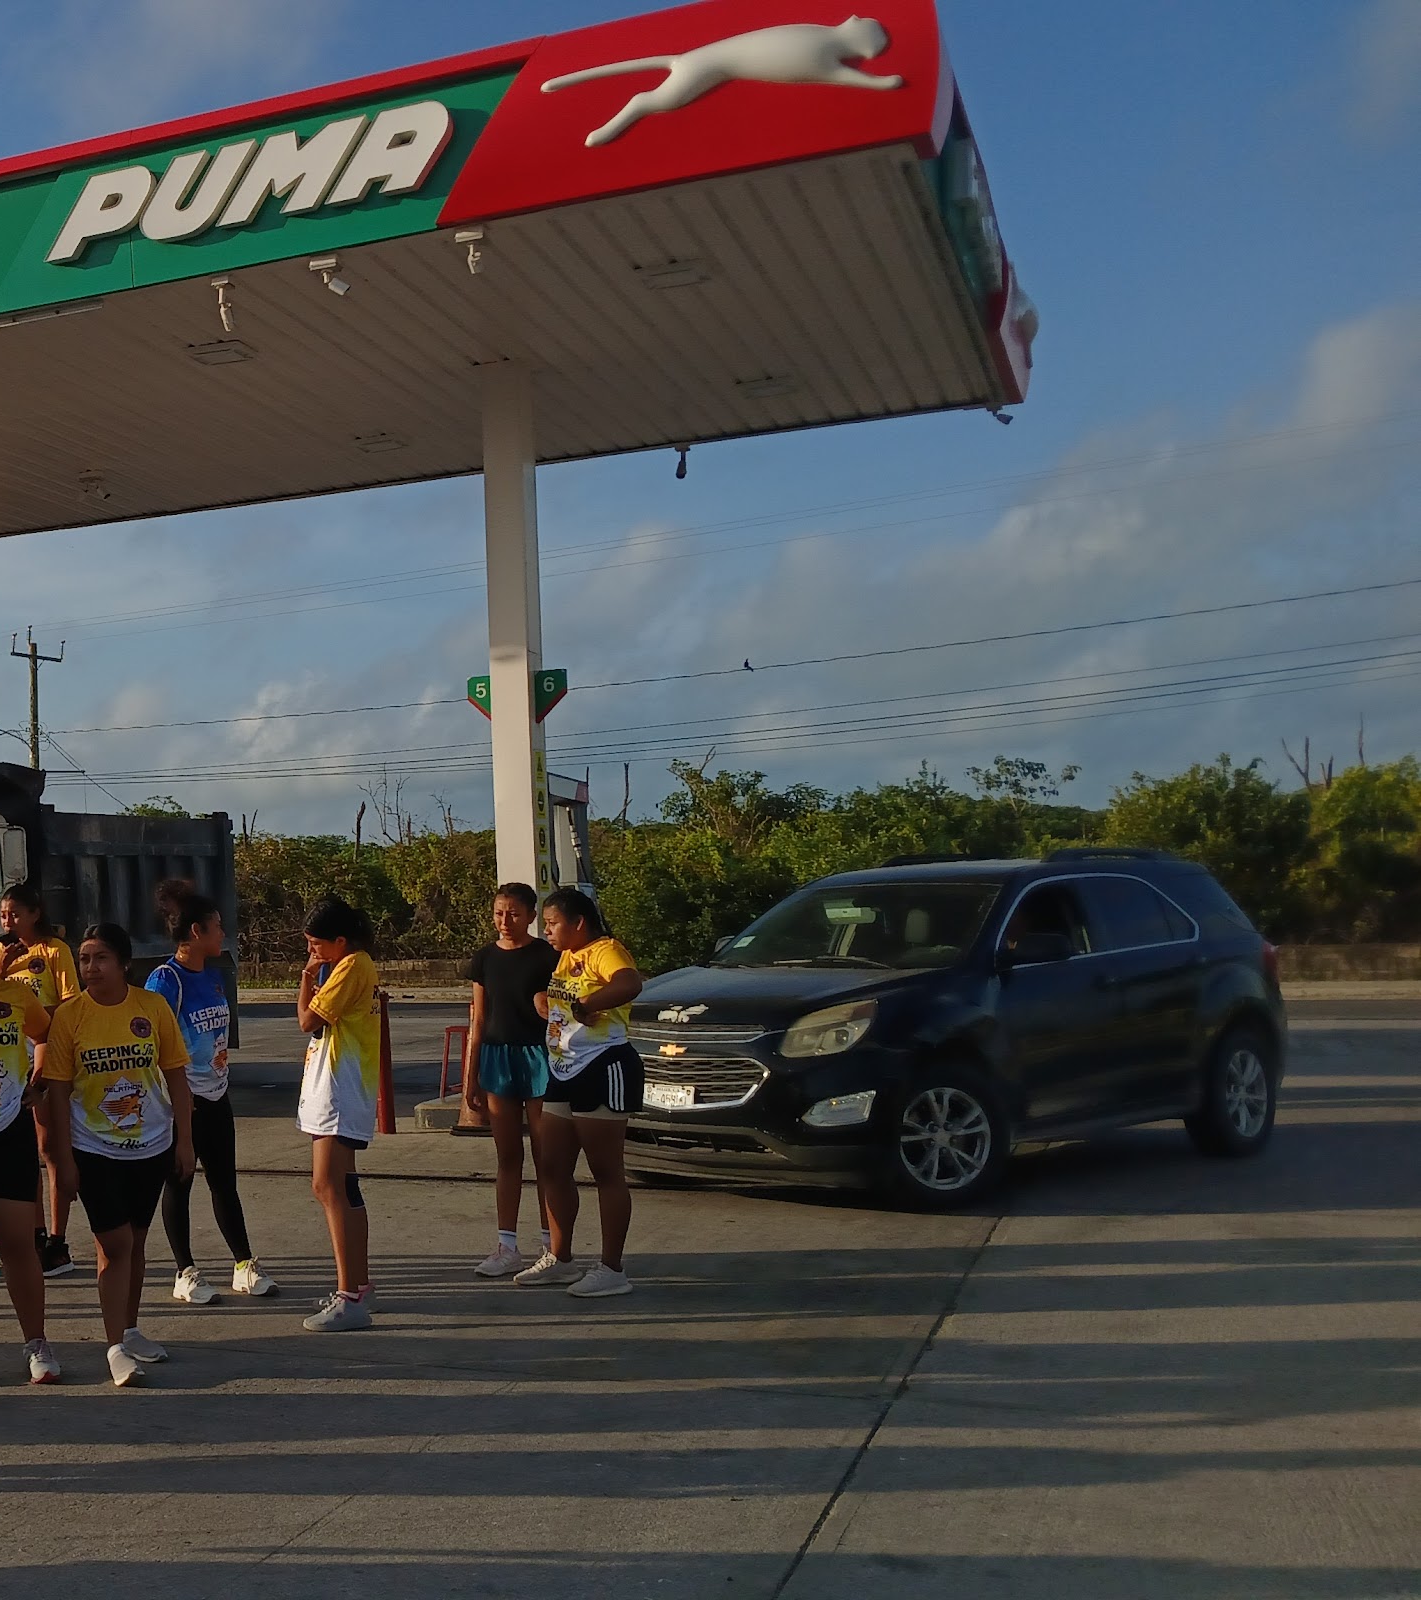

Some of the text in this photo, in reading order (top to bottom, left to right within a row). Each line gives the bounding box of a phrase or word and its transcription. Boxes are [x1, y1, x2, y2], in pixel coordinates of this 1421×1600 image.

[44, 100, 454, 263] PUMA
[475, 682, 487, 698] 5
[543, 676, 555, 692] 6
[194, 1016, 230, 1034] TRADIT
[80, 1044, 140, 1062] KEEPING
[83, 1056, 153, 1075] TRADITION
